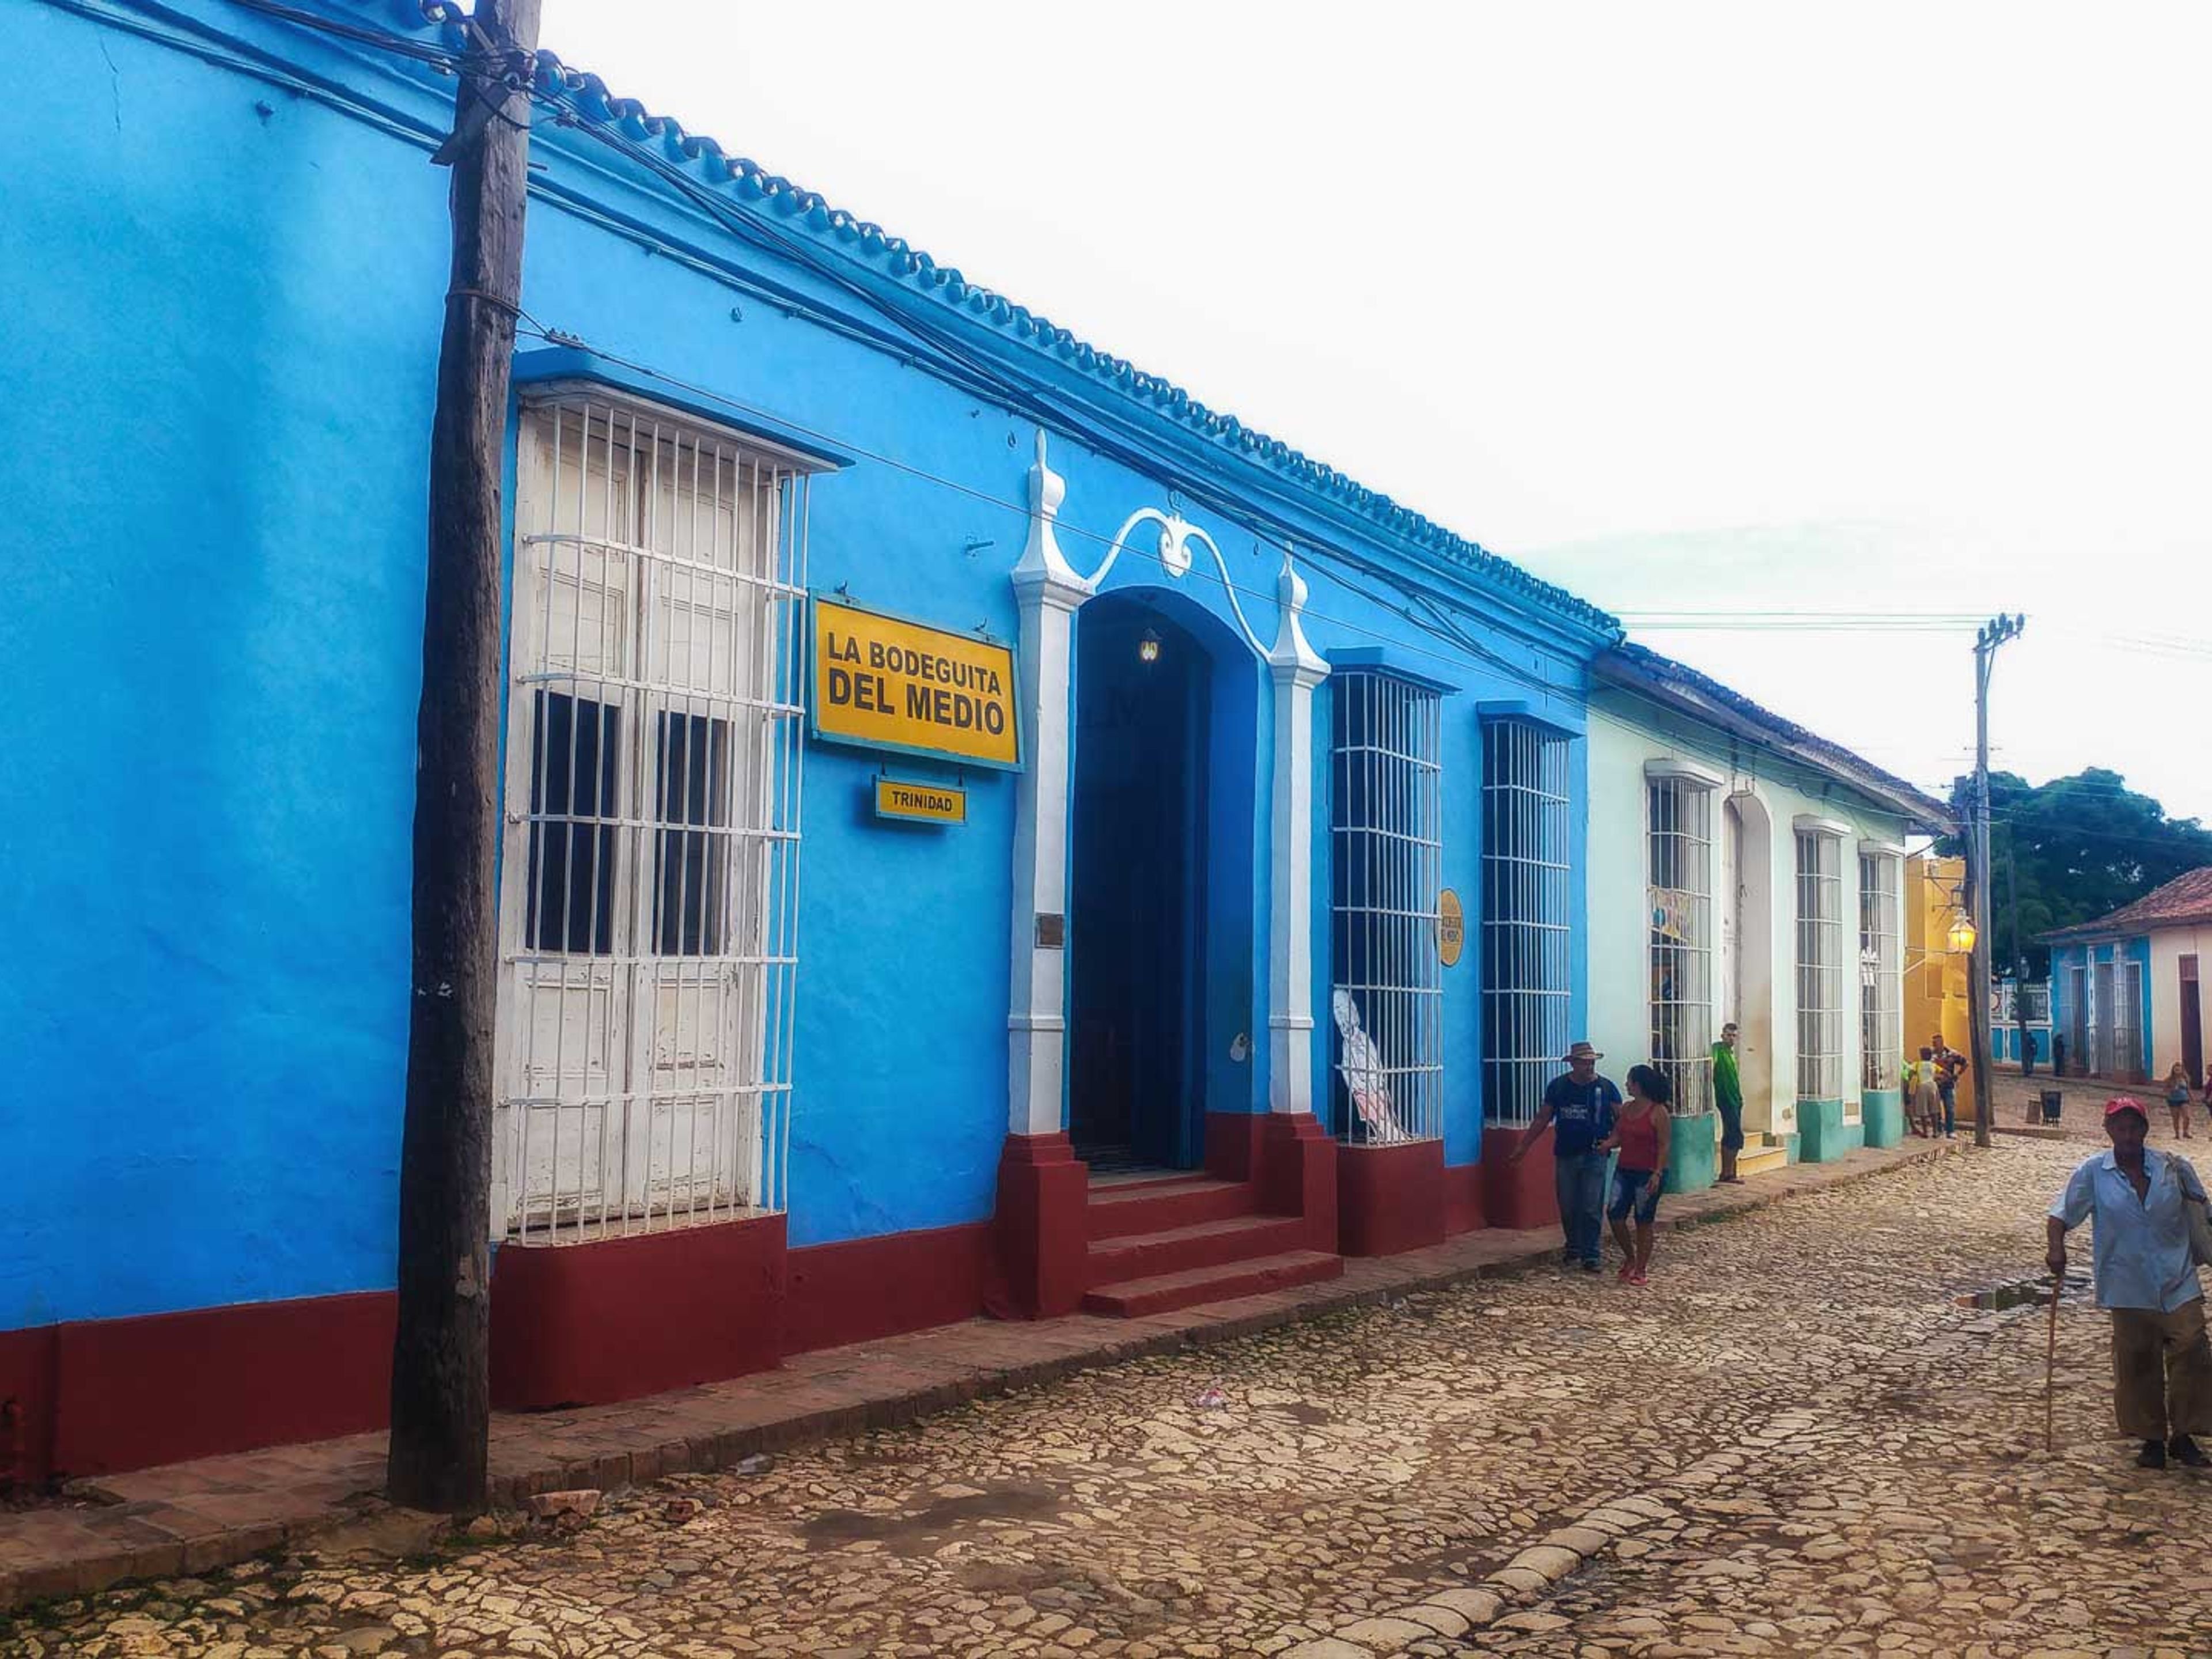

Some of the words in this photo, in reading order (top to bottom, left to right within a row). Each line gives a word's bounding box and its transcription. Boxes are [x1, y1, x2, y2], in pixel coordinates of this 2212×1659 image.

[828, 632, 861, 664] LA
[869, 641, 1002, 696] BODEGUITA
[829, 668, 895, 715] DEL
[907, 684, 1004, 736] MEDIO
[892, 791, 952, 812] TRINIDAD
